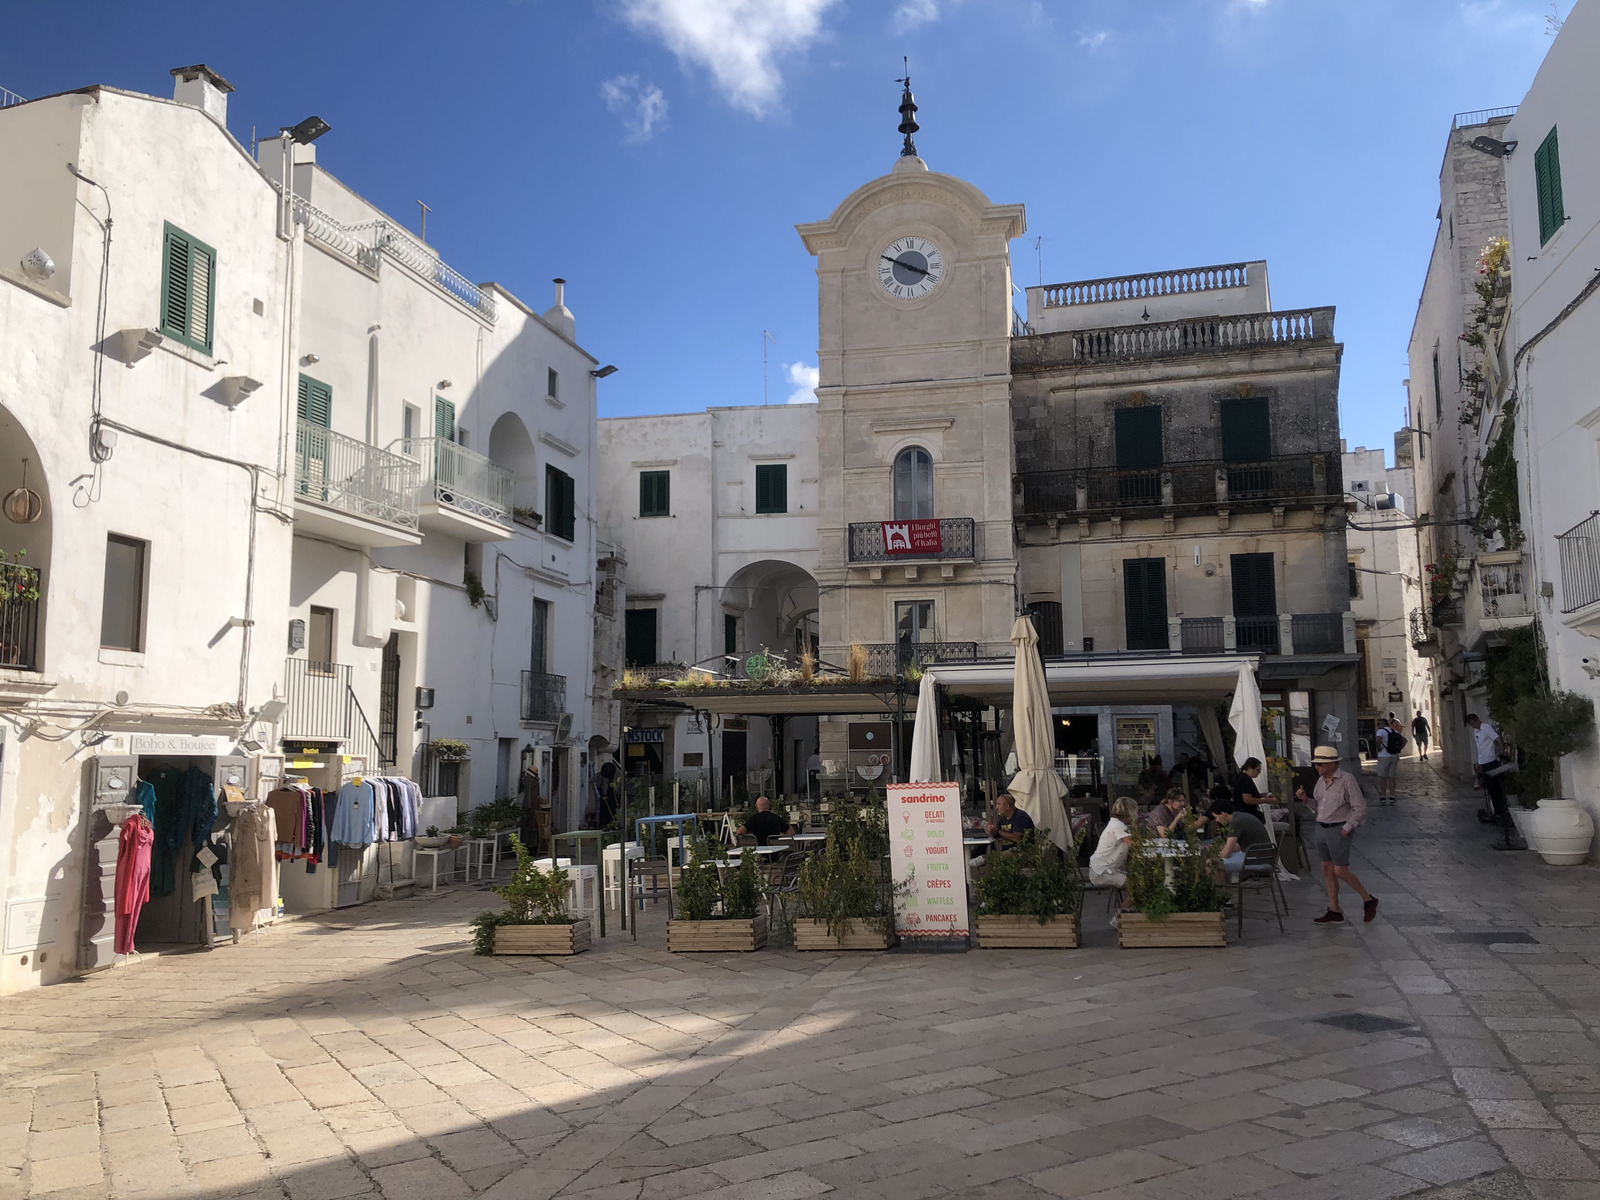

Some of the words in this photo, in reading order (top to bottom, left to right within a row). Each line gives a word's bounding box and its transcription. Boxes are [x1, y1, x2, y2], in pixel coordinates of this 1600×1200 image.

[915, 522, 936, 531] Borghi
[135, 737, 166, 750] Boho
[167, 739, 177, 750] &
[180, 738, 216, 752] Boujee
[901, 793, 946, 803] sandrino
[924, 810, 945, 819] GELATI
[927, 830, 945, 838] DOLCI
[925, 846, 949, 855] YOGURT
[926, 862, 950, 872] FRUTTA
[926, 878, 951, 889] CRÊPES
[926, 896, 954, 905] WAFFLES
[925, 913, 958, 923] PANCAKES
